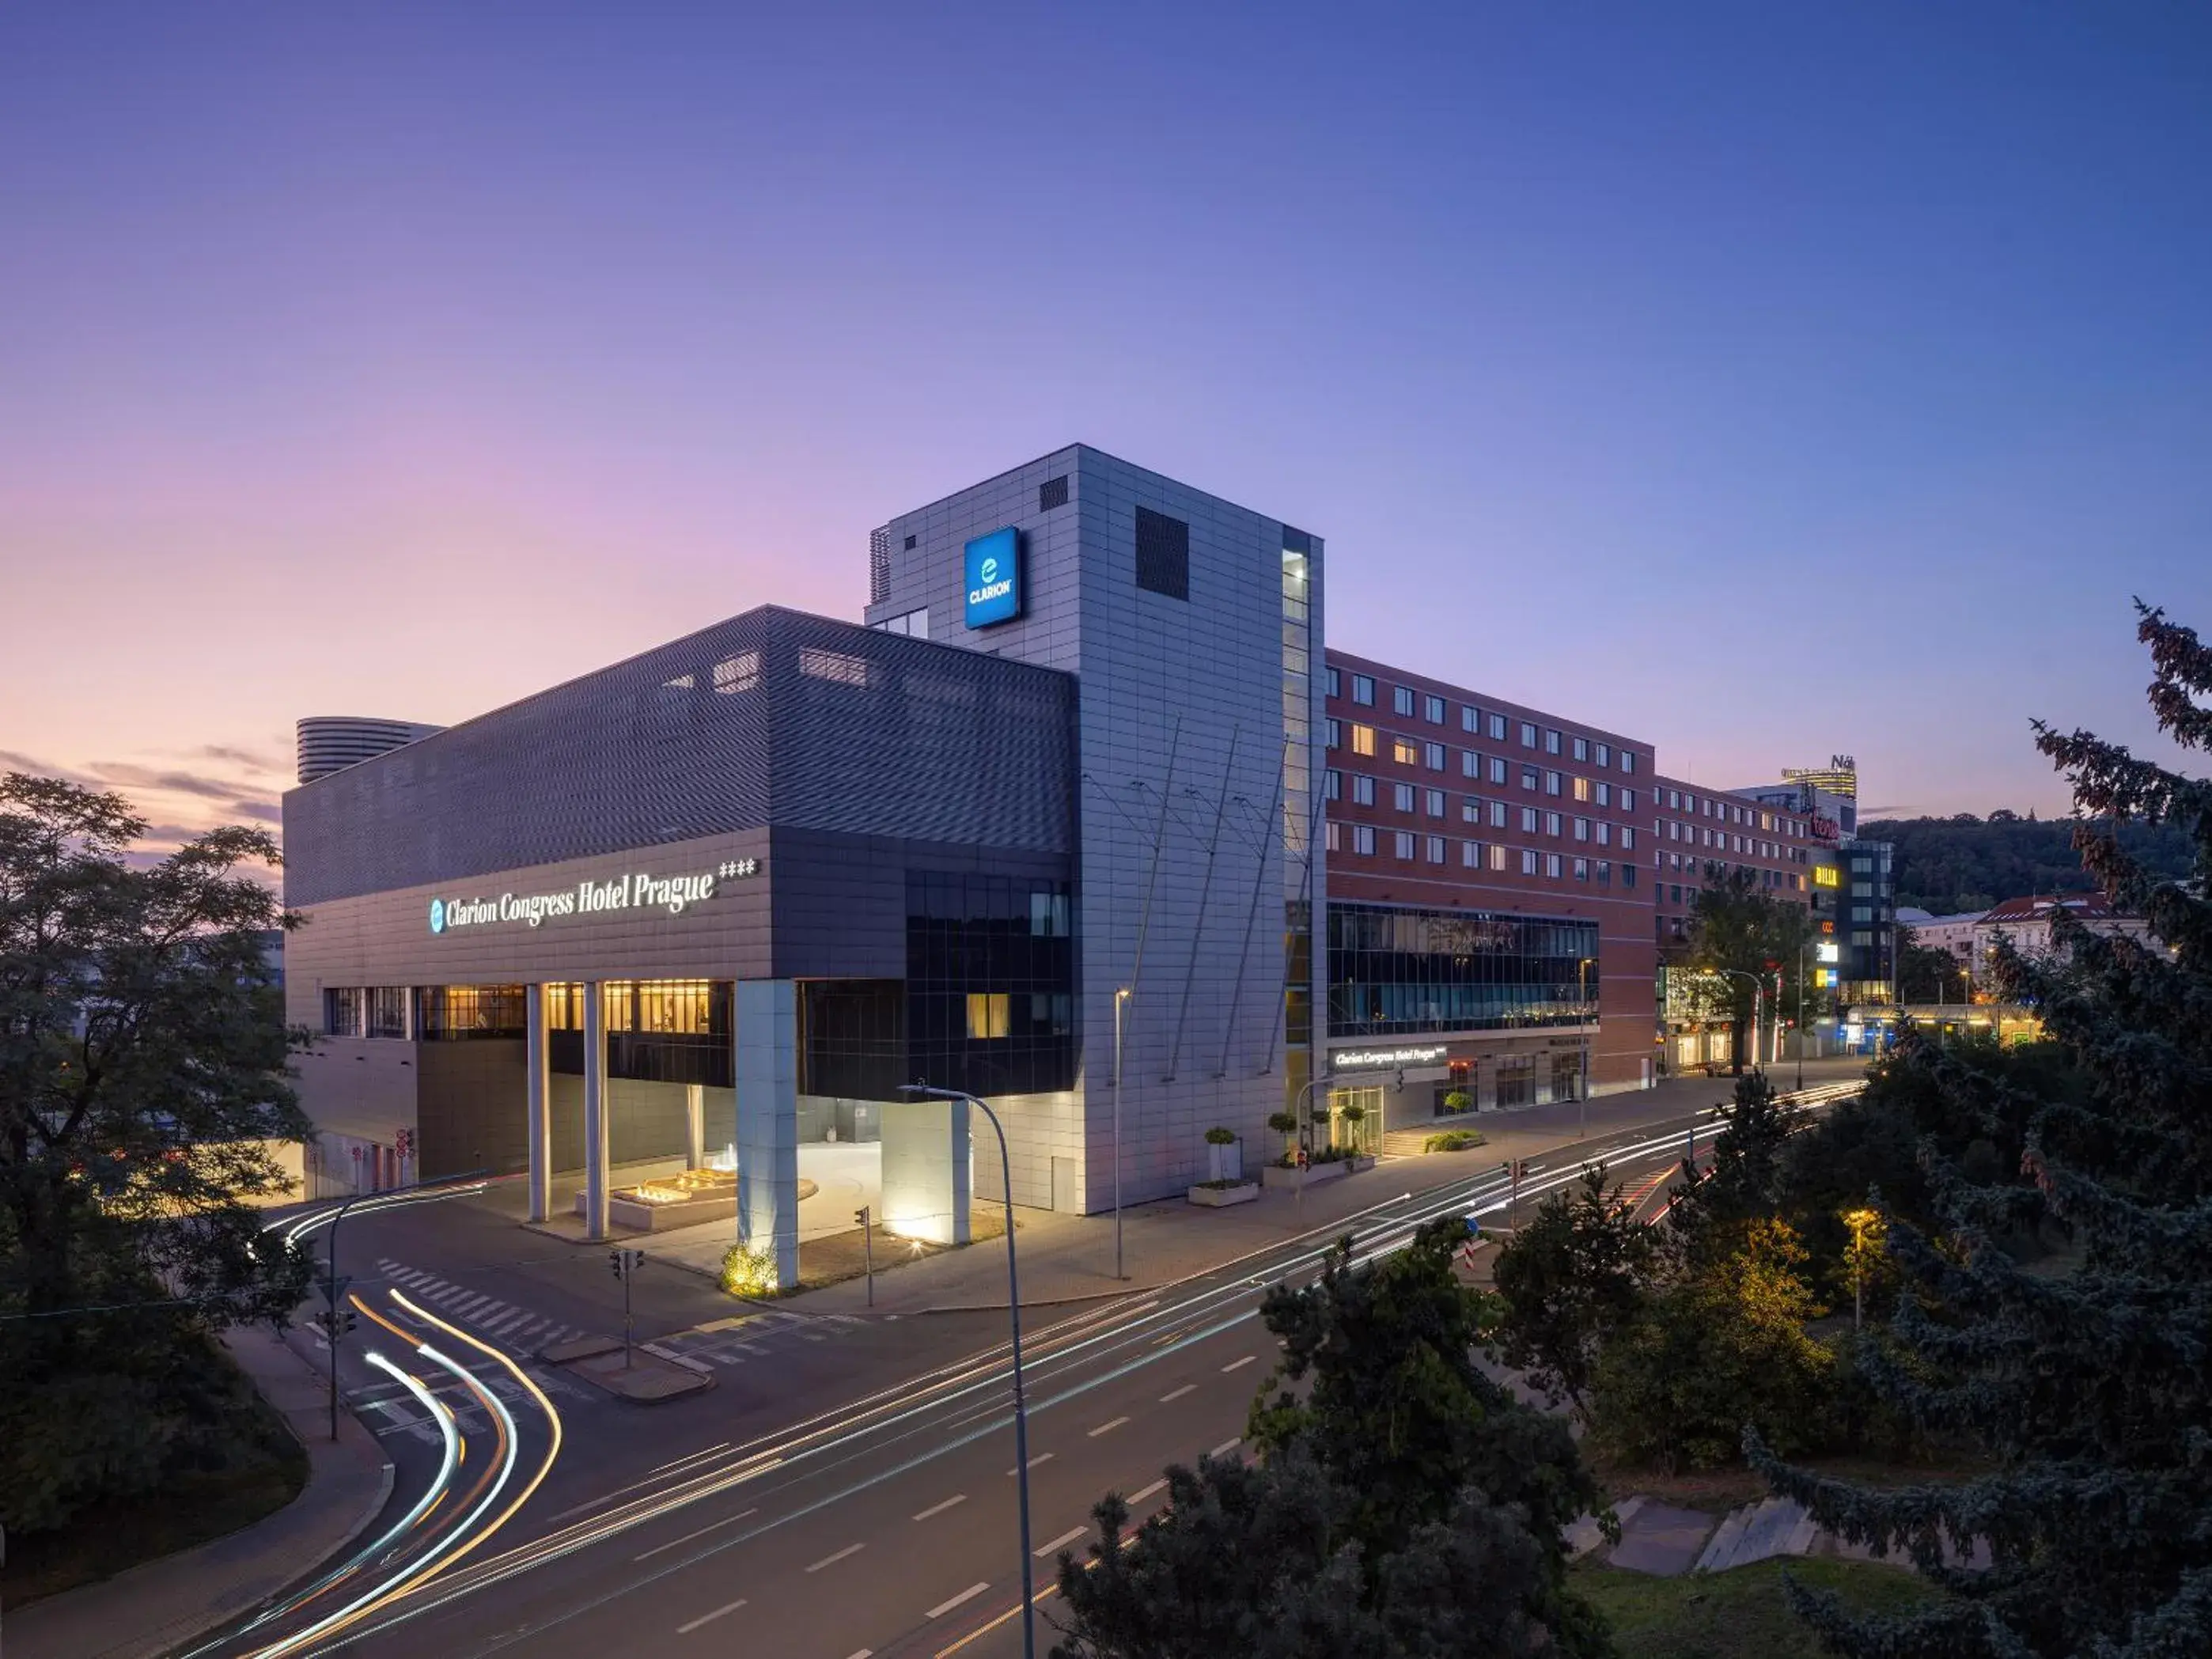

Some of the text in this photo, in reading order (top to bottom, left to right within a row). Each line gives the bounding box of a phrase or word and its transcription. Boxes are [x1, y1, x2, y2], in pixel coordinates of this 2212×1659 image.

[969, 579, 1010, 604] CLARION
[1816, 866, 1838, 885] BILLA
[446, 873, 714, 927] Clarion Congress Hotel Prague
